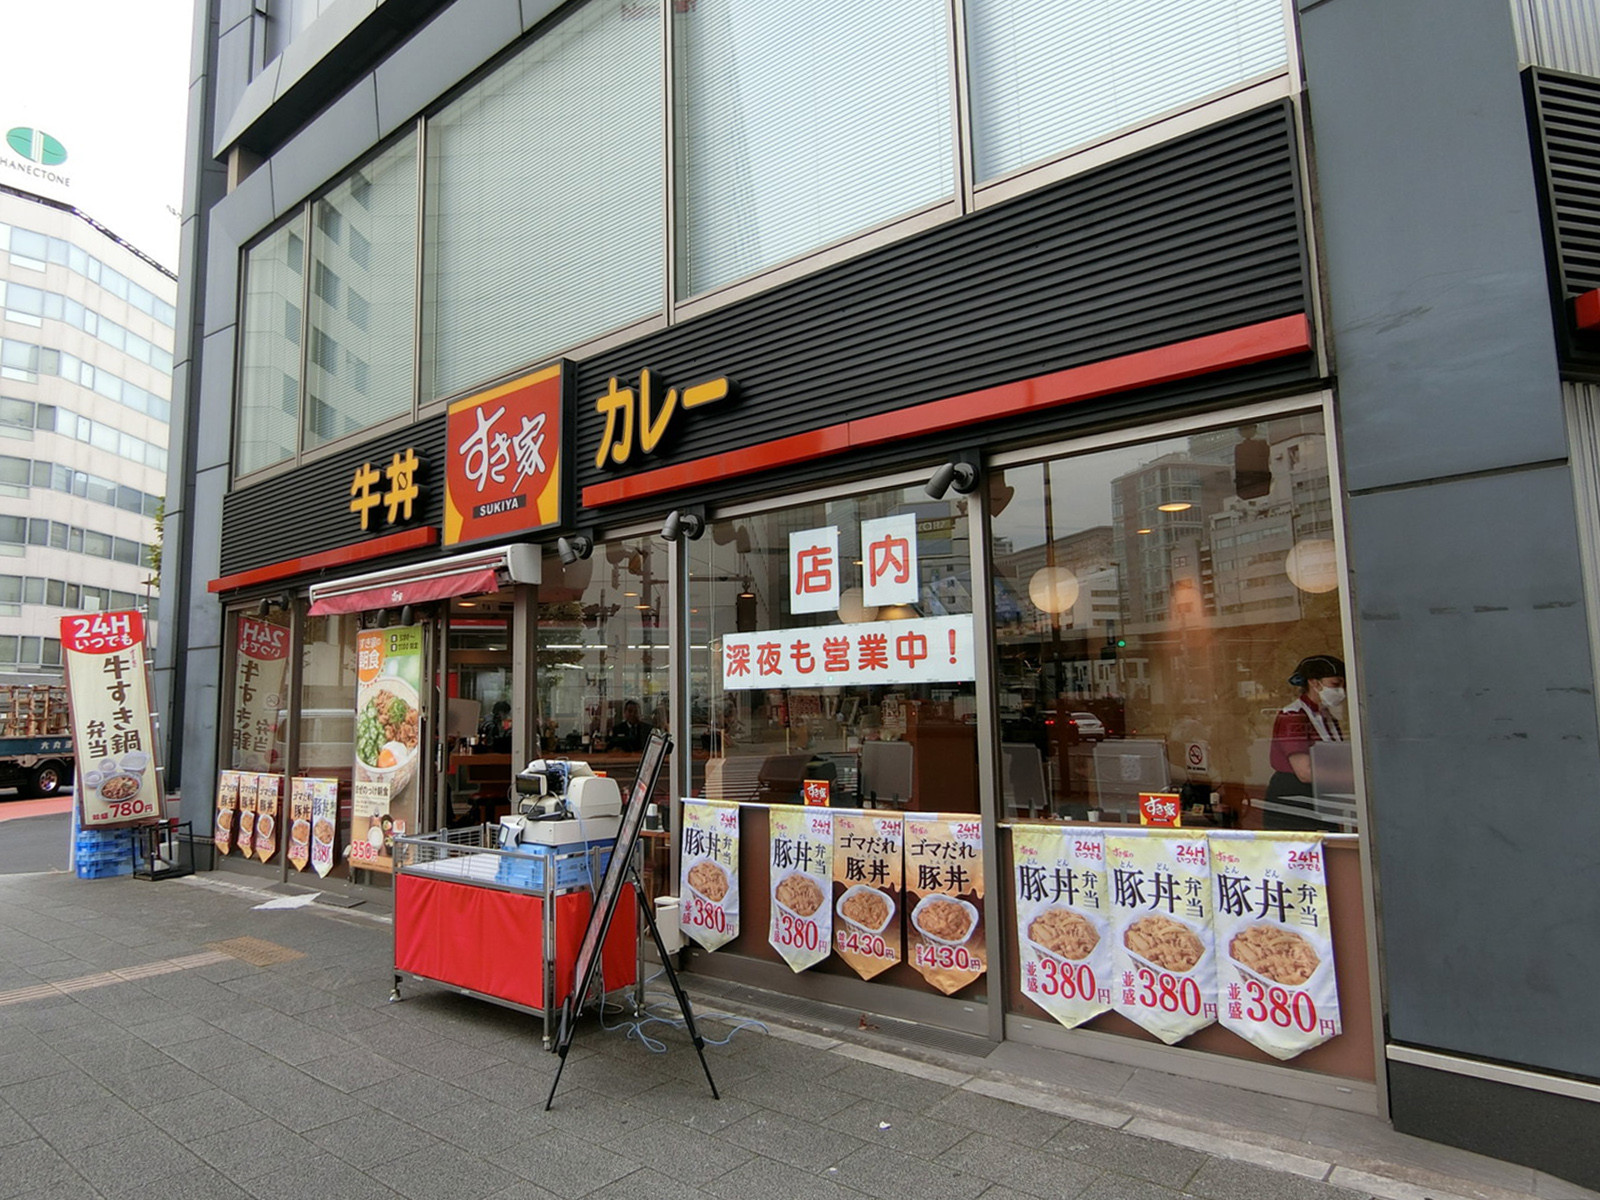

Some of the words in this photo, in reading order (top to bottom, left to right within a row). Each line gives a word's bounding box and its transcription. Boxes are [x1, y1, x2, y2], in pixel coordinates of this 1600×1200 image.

[0, 157, 70, 187] HANECTONE
[595, 368, 728, 469] カレー
[459, 405, 546, 493] すき家
[350, 447, 420, 530] 牛丼
[480, 498, 519, 517] SUKIYA
[73, 614, 131, 638] 24H
[75, 633, 133, 650] いつでも
[726, 629, 957, 676] 深夜も営業中！
[104, 656, 142, 754] 牛すき鍋
[87, 720, 109, 758] 弁当
[109, 800, 154, 818] 780円
[1144, 796, 1176, 818] すき家
[812, 819, 830, 829] 24H
[881, 820, 901, 830] 24H
[957, 823, 980, 834] 24H
[684, 827, 720, 861] 豚丼
[772, 838, 812, 872] 豚丼
[840, 832, 898, 854] ゴマだれ
[911, 838, 977, 860] ゴマだれ
[1075, 840, 1101, 853] 24H
[1075, 852, 1102, 861] いつでも
[1176, 845, 1205, 858] 24H
[1288, 851, 1320, 863] 24H
[815, 843, 826, 875] 弁当
[845, 856, 890, 885] 豚丼
[1176, 856, 1207, 866] いつでも
[1288, 863, 1320, 871] いつでも
[917, 864, 970, 892] 豚丼
[1019, 865, 1080, 905] 豚丼
[1082, 871, 1099, 909] 弁当
[1113, 868, 1182, 913] 豚丼
[1184, 877, 1203, 918] 弁当
[1217, 873, 1295, 923] 豚丼
[1297, 884, 1318, 927] 弁当
[1026, 961, 1038, 993] 並盛
[1122, 971, 1135, 1005] 並盛
[1228, 983, 1242, 1020] 並盛
